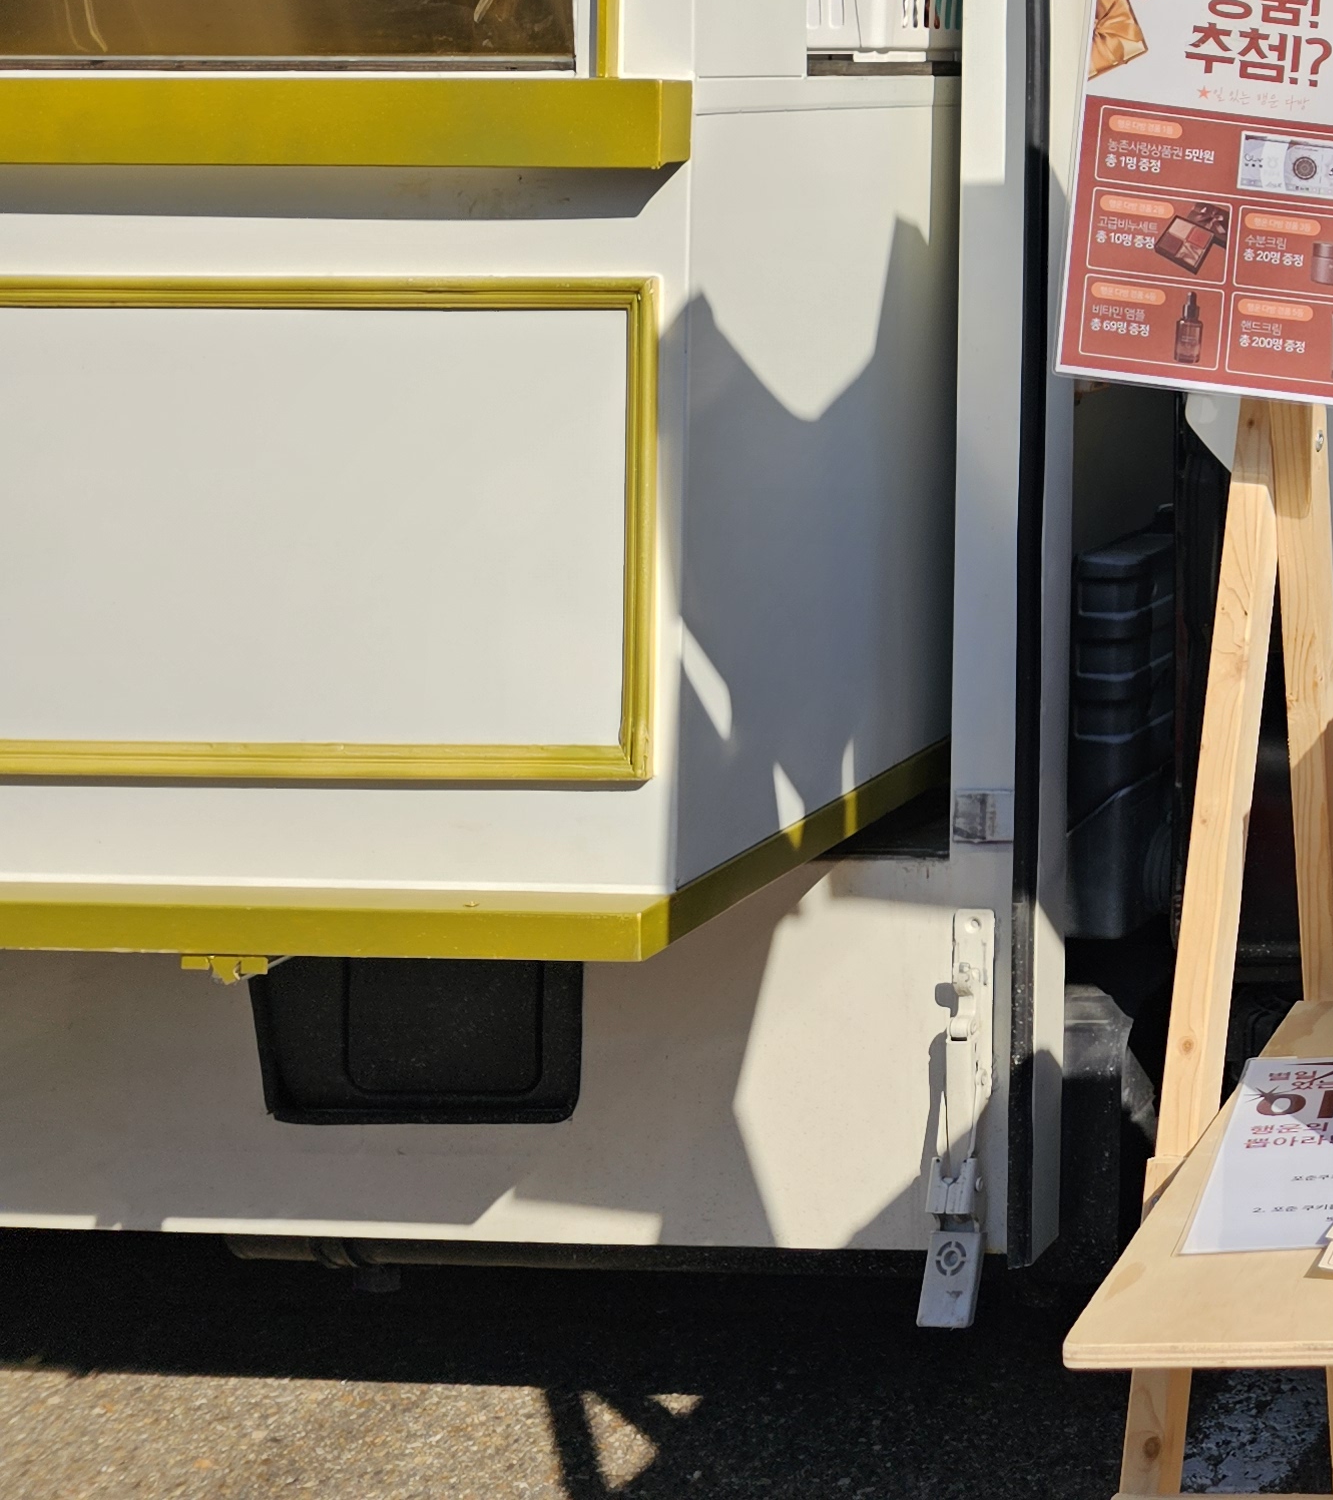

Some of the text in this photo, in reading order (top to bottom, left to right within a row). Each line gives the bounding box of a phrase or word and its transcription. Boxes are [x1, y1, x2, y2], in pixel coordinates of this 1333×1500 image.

[1185, 21, 1332, 87] 추첨!?
[1229, 88, 1250, 105] 있는
[1257, 92, 1279, 108] 행운
[1107, 138, 1214, 164] 농촌사랑상품권 5만원
[1105, 153, 1161, 173] 총 1명 증정
[1097, 215, 1158, 233] 고급비누세트
[1096, 230, 1155, 250] 총 10명 증정
[1244, 234, 1287, 250] 수분크림
[1243, 248, 1304, 267] 총 20명 증정
[1092, 304, 1146, 322] 비타민 앰플
[1090, 318, 1150, 337] 총 69명 증정
[1241, 320, 1282, 336] 핸드크림
[1239, 334, 1306, 354] 총 200명 증정
[1268, 1070, 1317, 1082] 별일
[1251, 1121, 1329, 1135] 행운의
